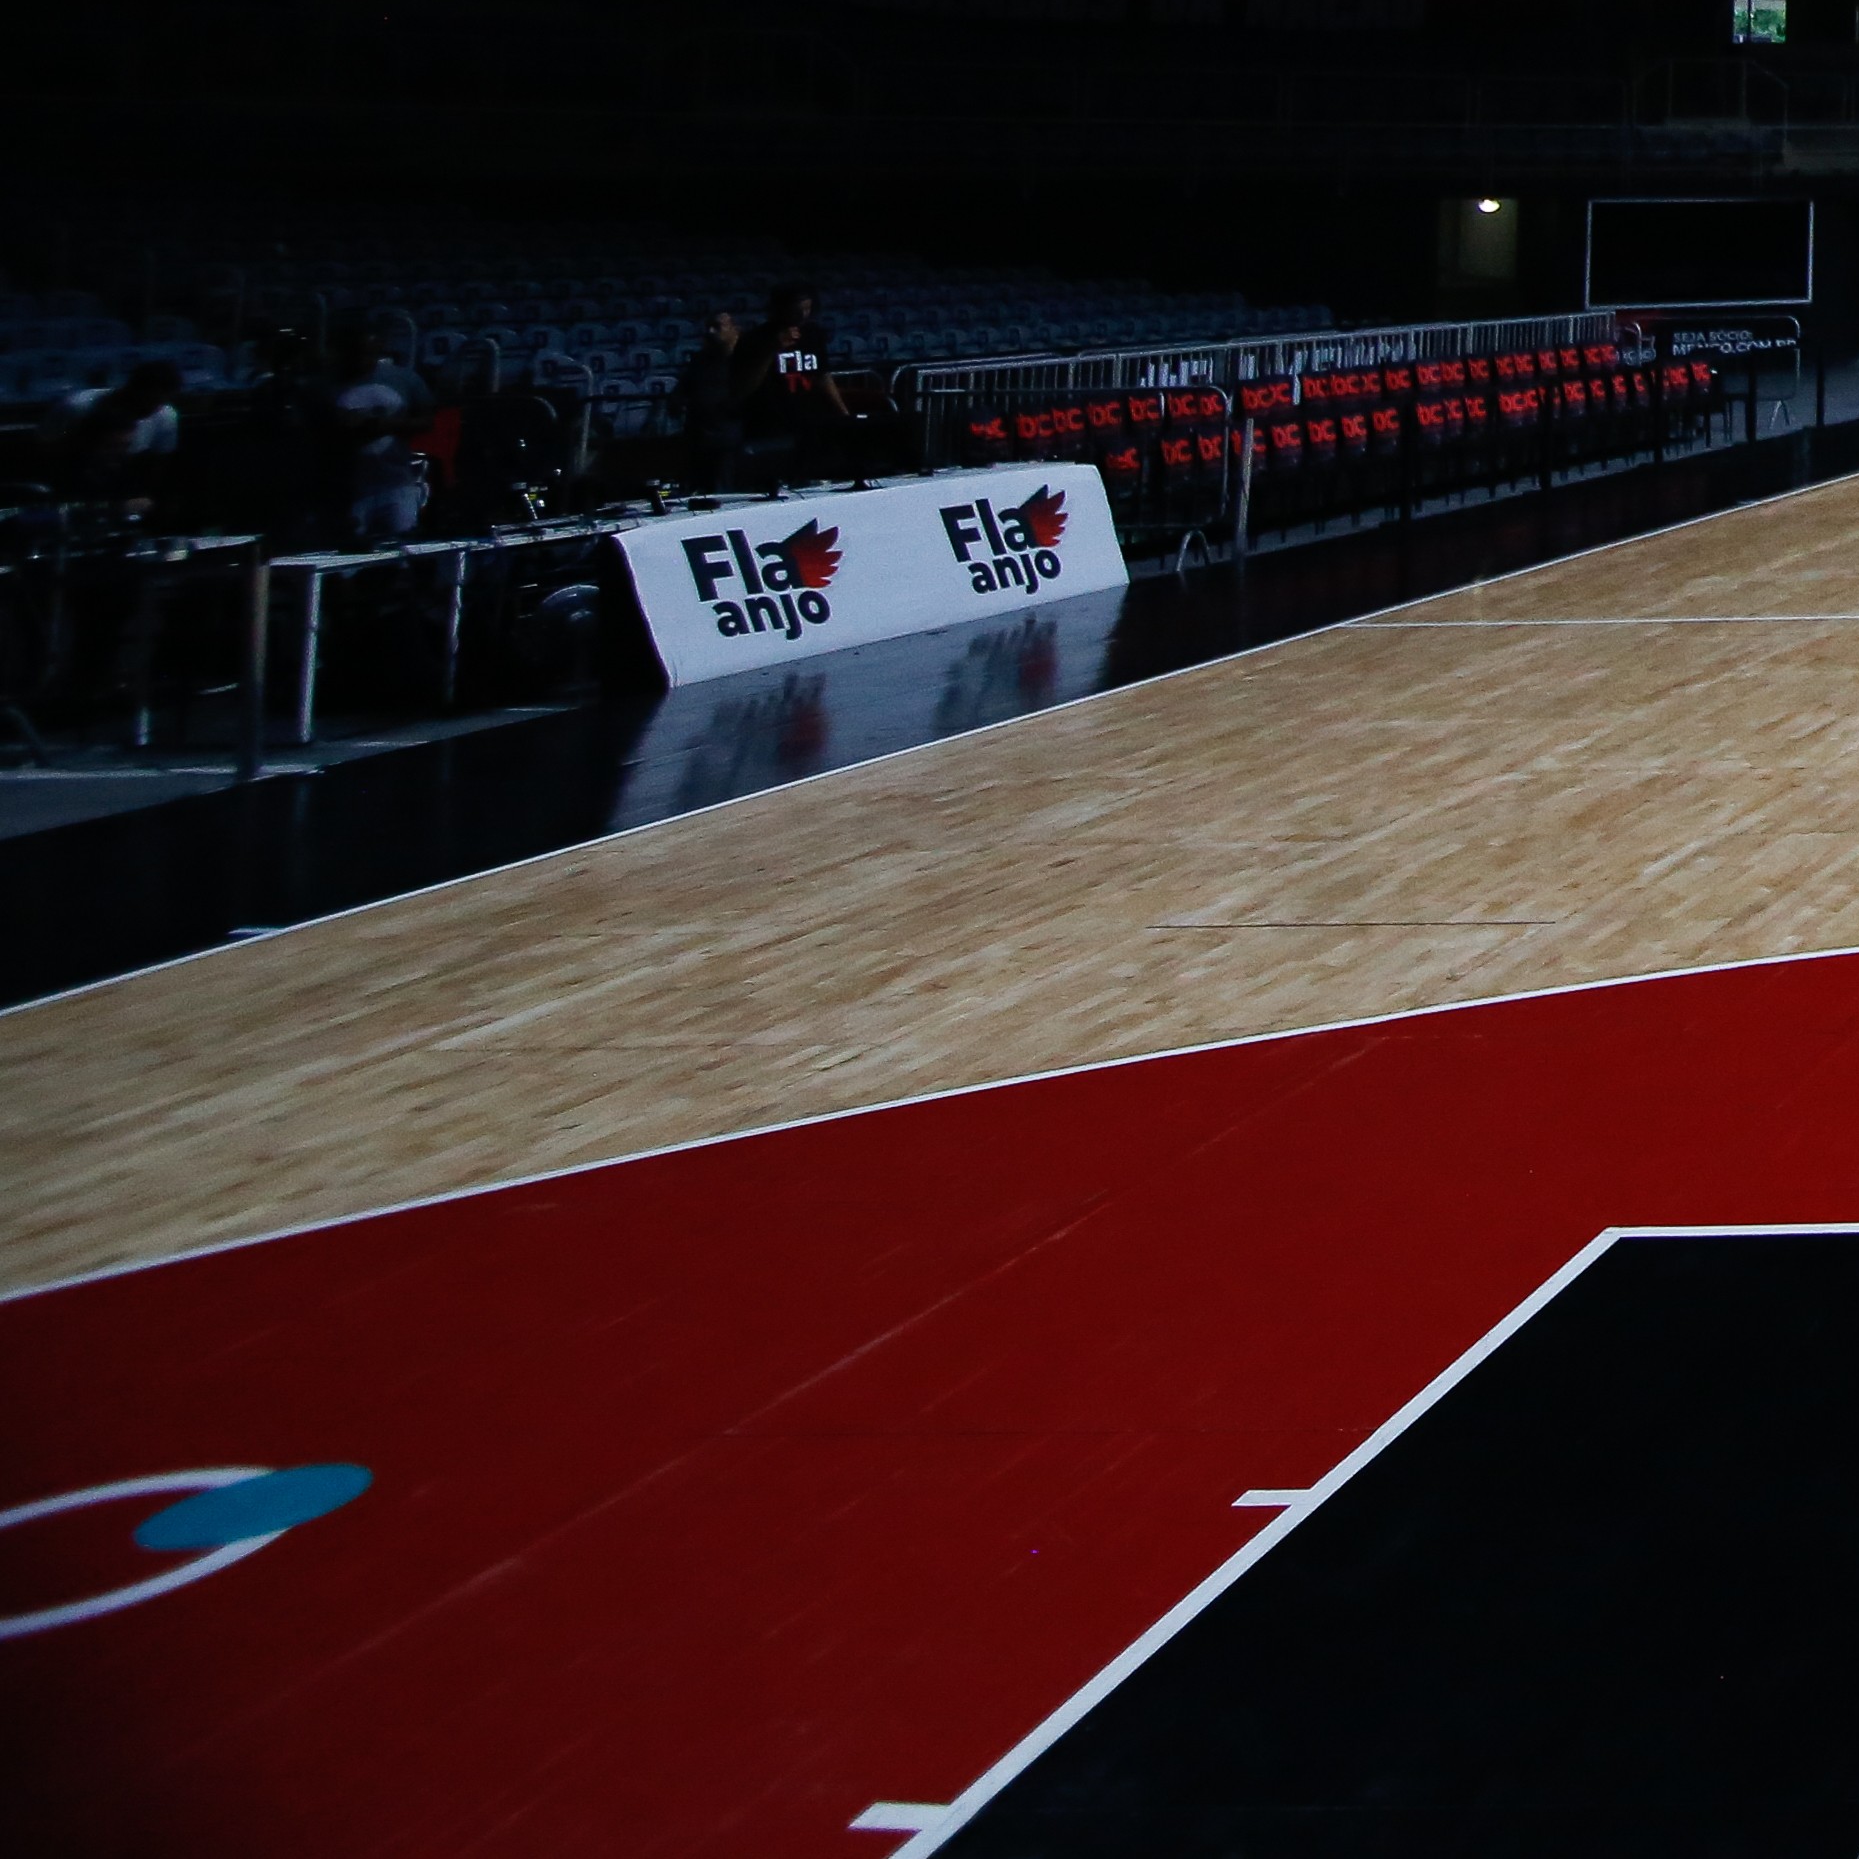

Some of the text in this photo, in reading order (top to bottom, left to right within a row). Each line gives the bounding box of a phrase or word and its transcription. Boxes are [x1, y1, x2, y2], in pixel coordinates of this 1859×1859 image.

[939, 498, 1038, 563] Fla
[681, 528, 806, 602] Fla
[967, 546, 1063, 595] anjo
[712, 588, 832, 641] anjo
